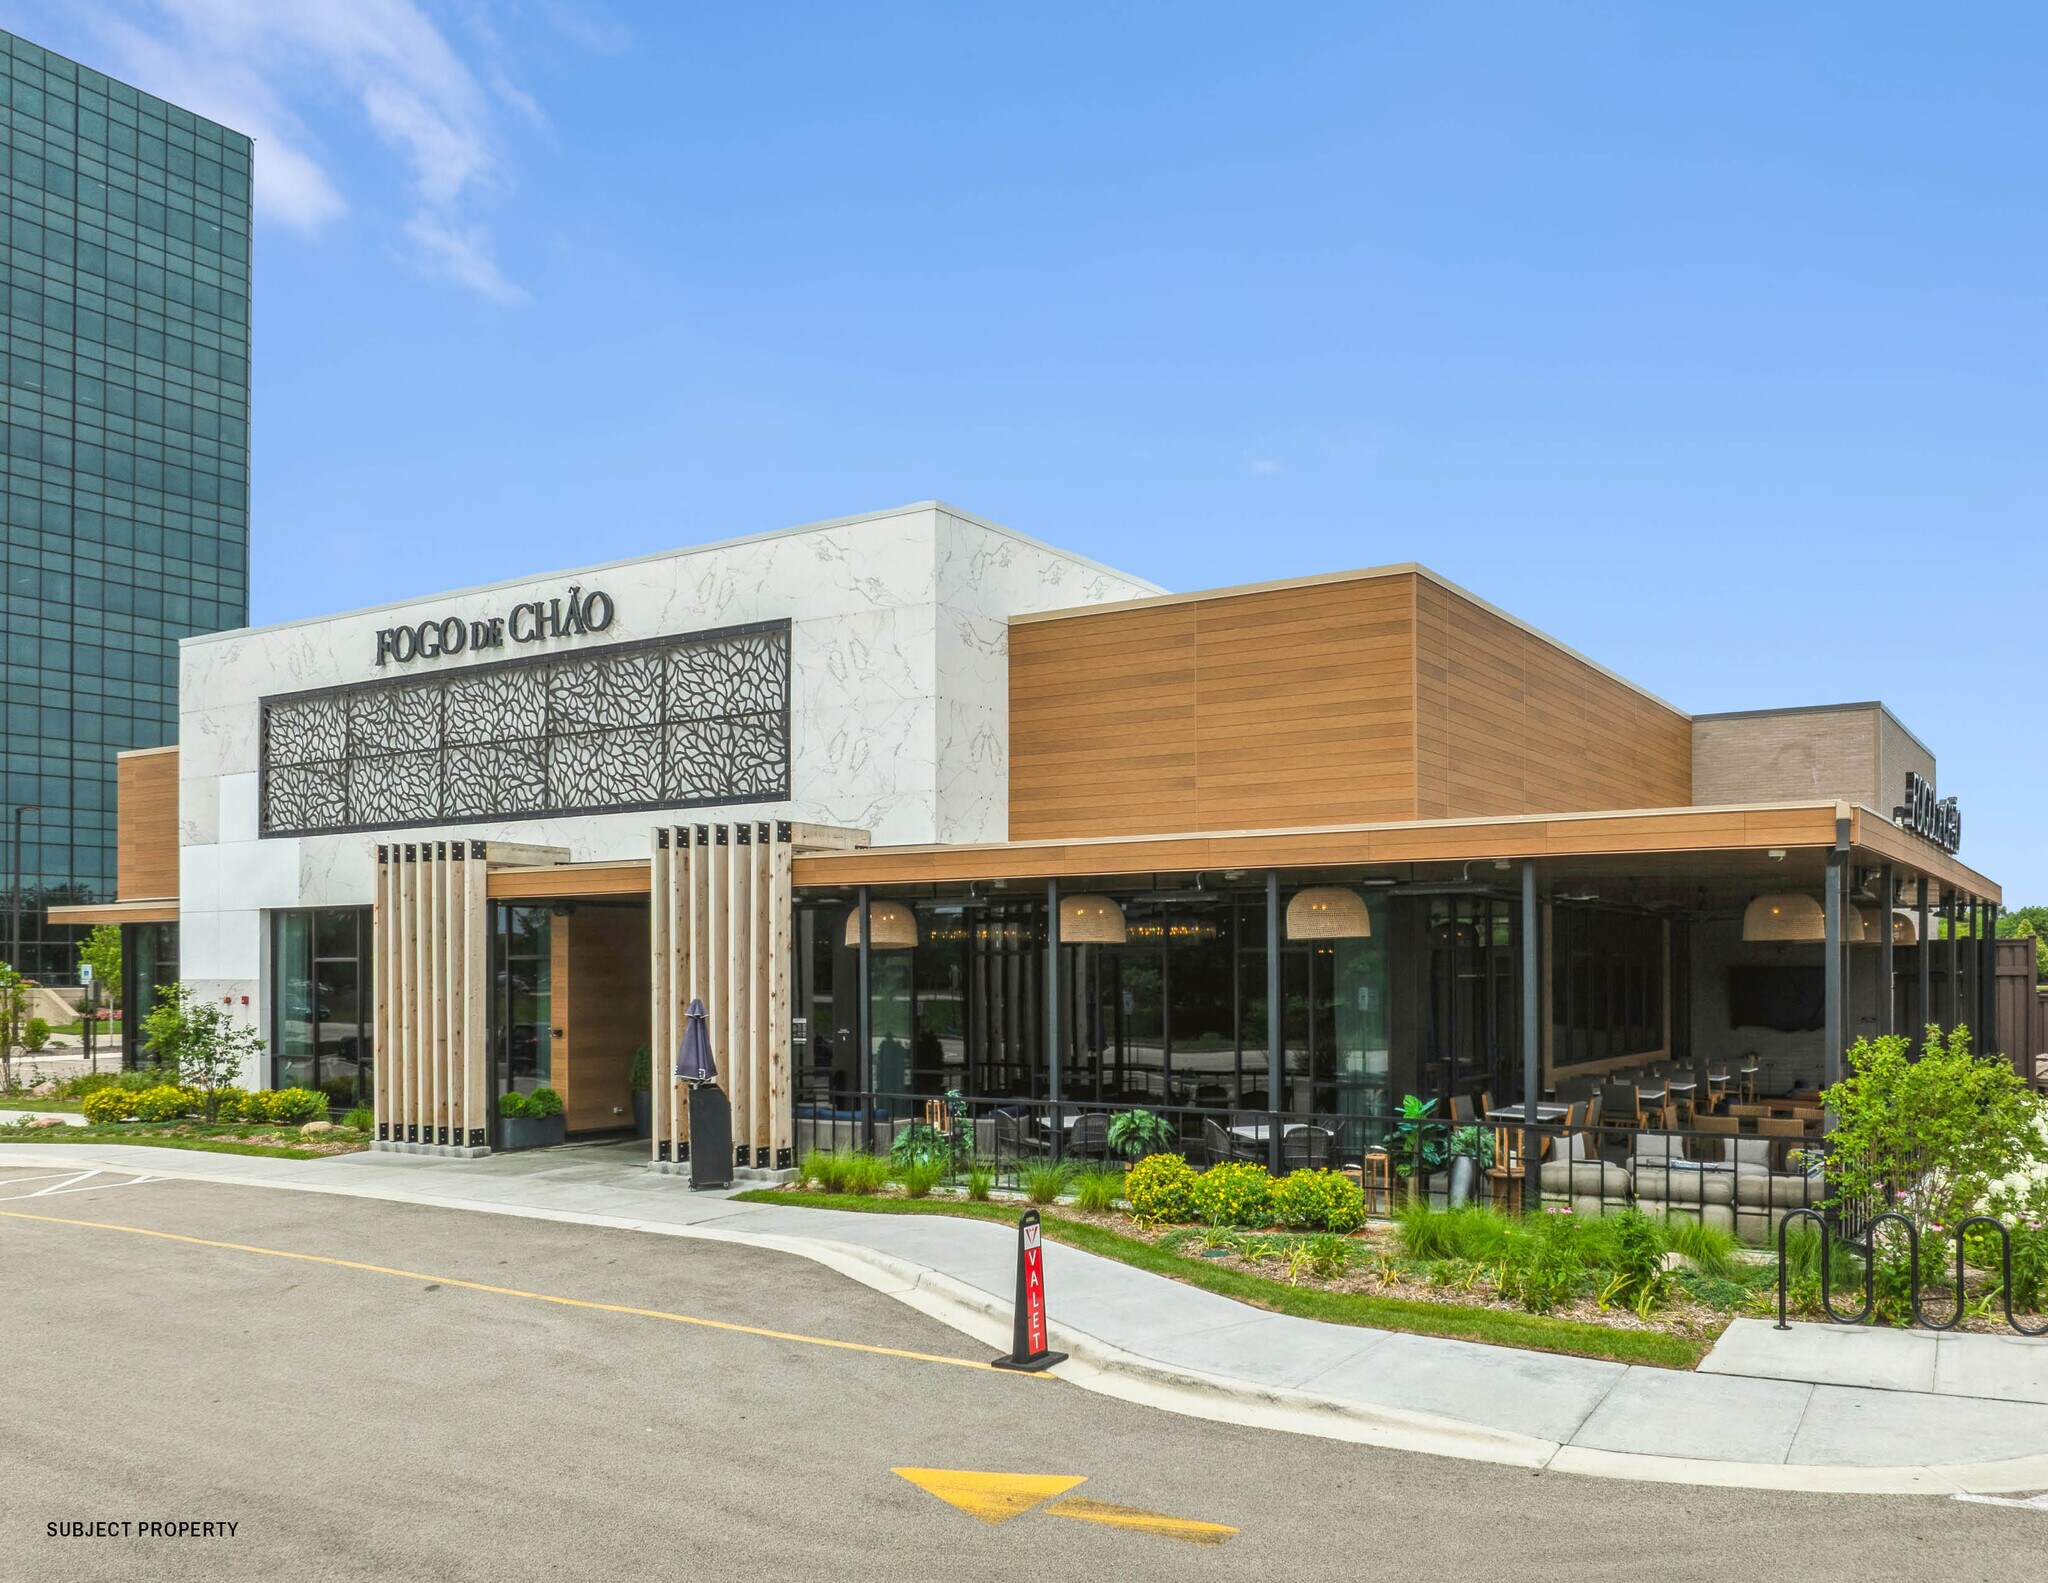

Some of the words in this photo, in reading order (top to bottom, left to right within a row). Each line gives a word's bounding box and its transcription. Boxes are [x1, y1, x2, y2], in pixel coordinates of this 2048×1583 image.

[375, 616, 467, 666] FOGO
[469, 617, 505, 651] DE
[508, 586, 615, 643] CHÃO
[1028, 1249, 1040, 1350] VALET
